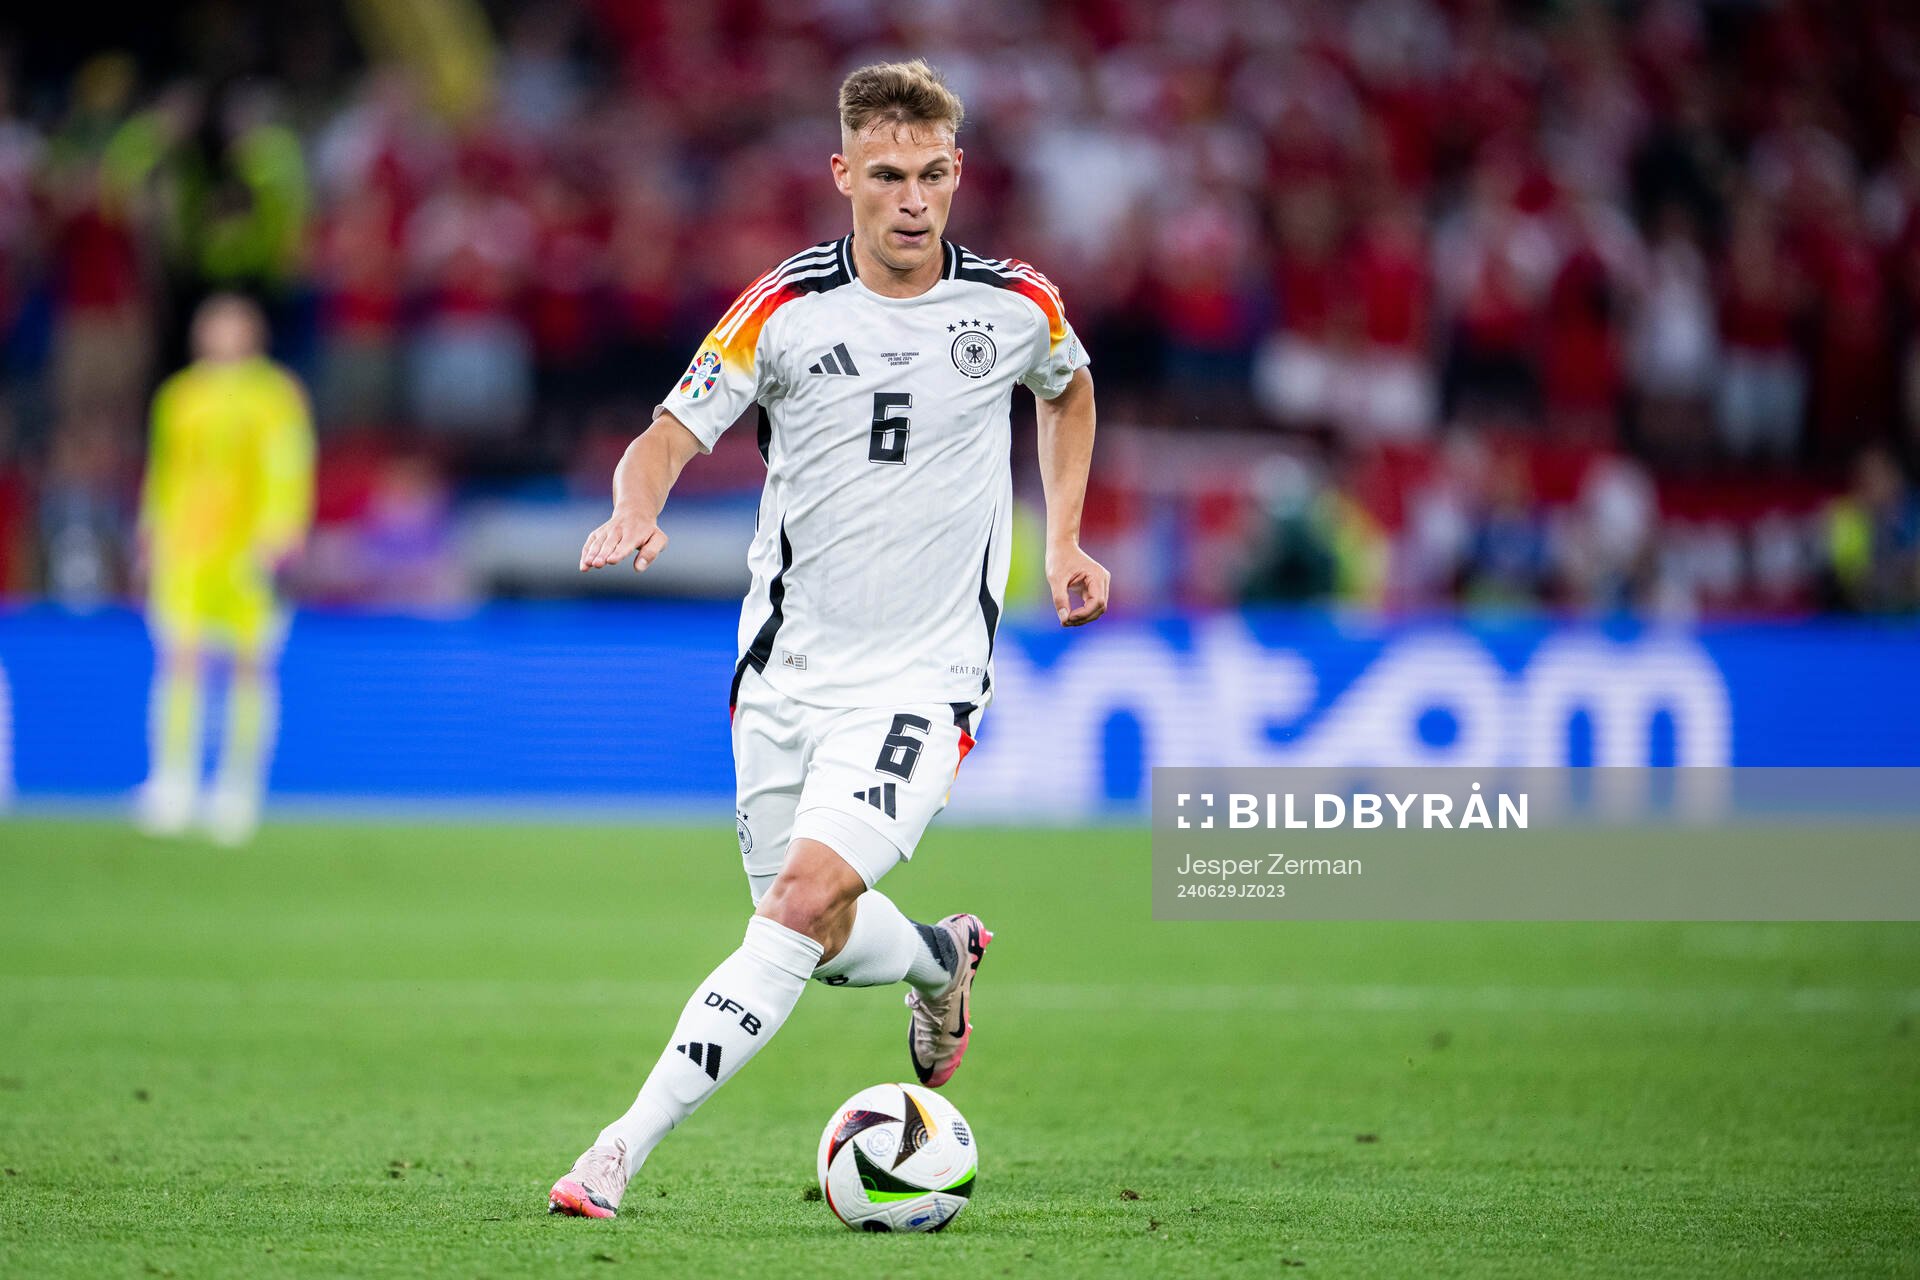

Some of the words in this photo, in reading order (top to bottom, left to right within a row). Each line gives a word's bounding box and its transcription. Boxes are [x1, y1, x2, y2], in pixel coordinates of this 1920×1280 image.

[868, 392, 913, 465] 6
[950, 665, 969, 674] HEAT
[875, 713, 932, 783] 6
[704, 991, 762, 1036] DFB
